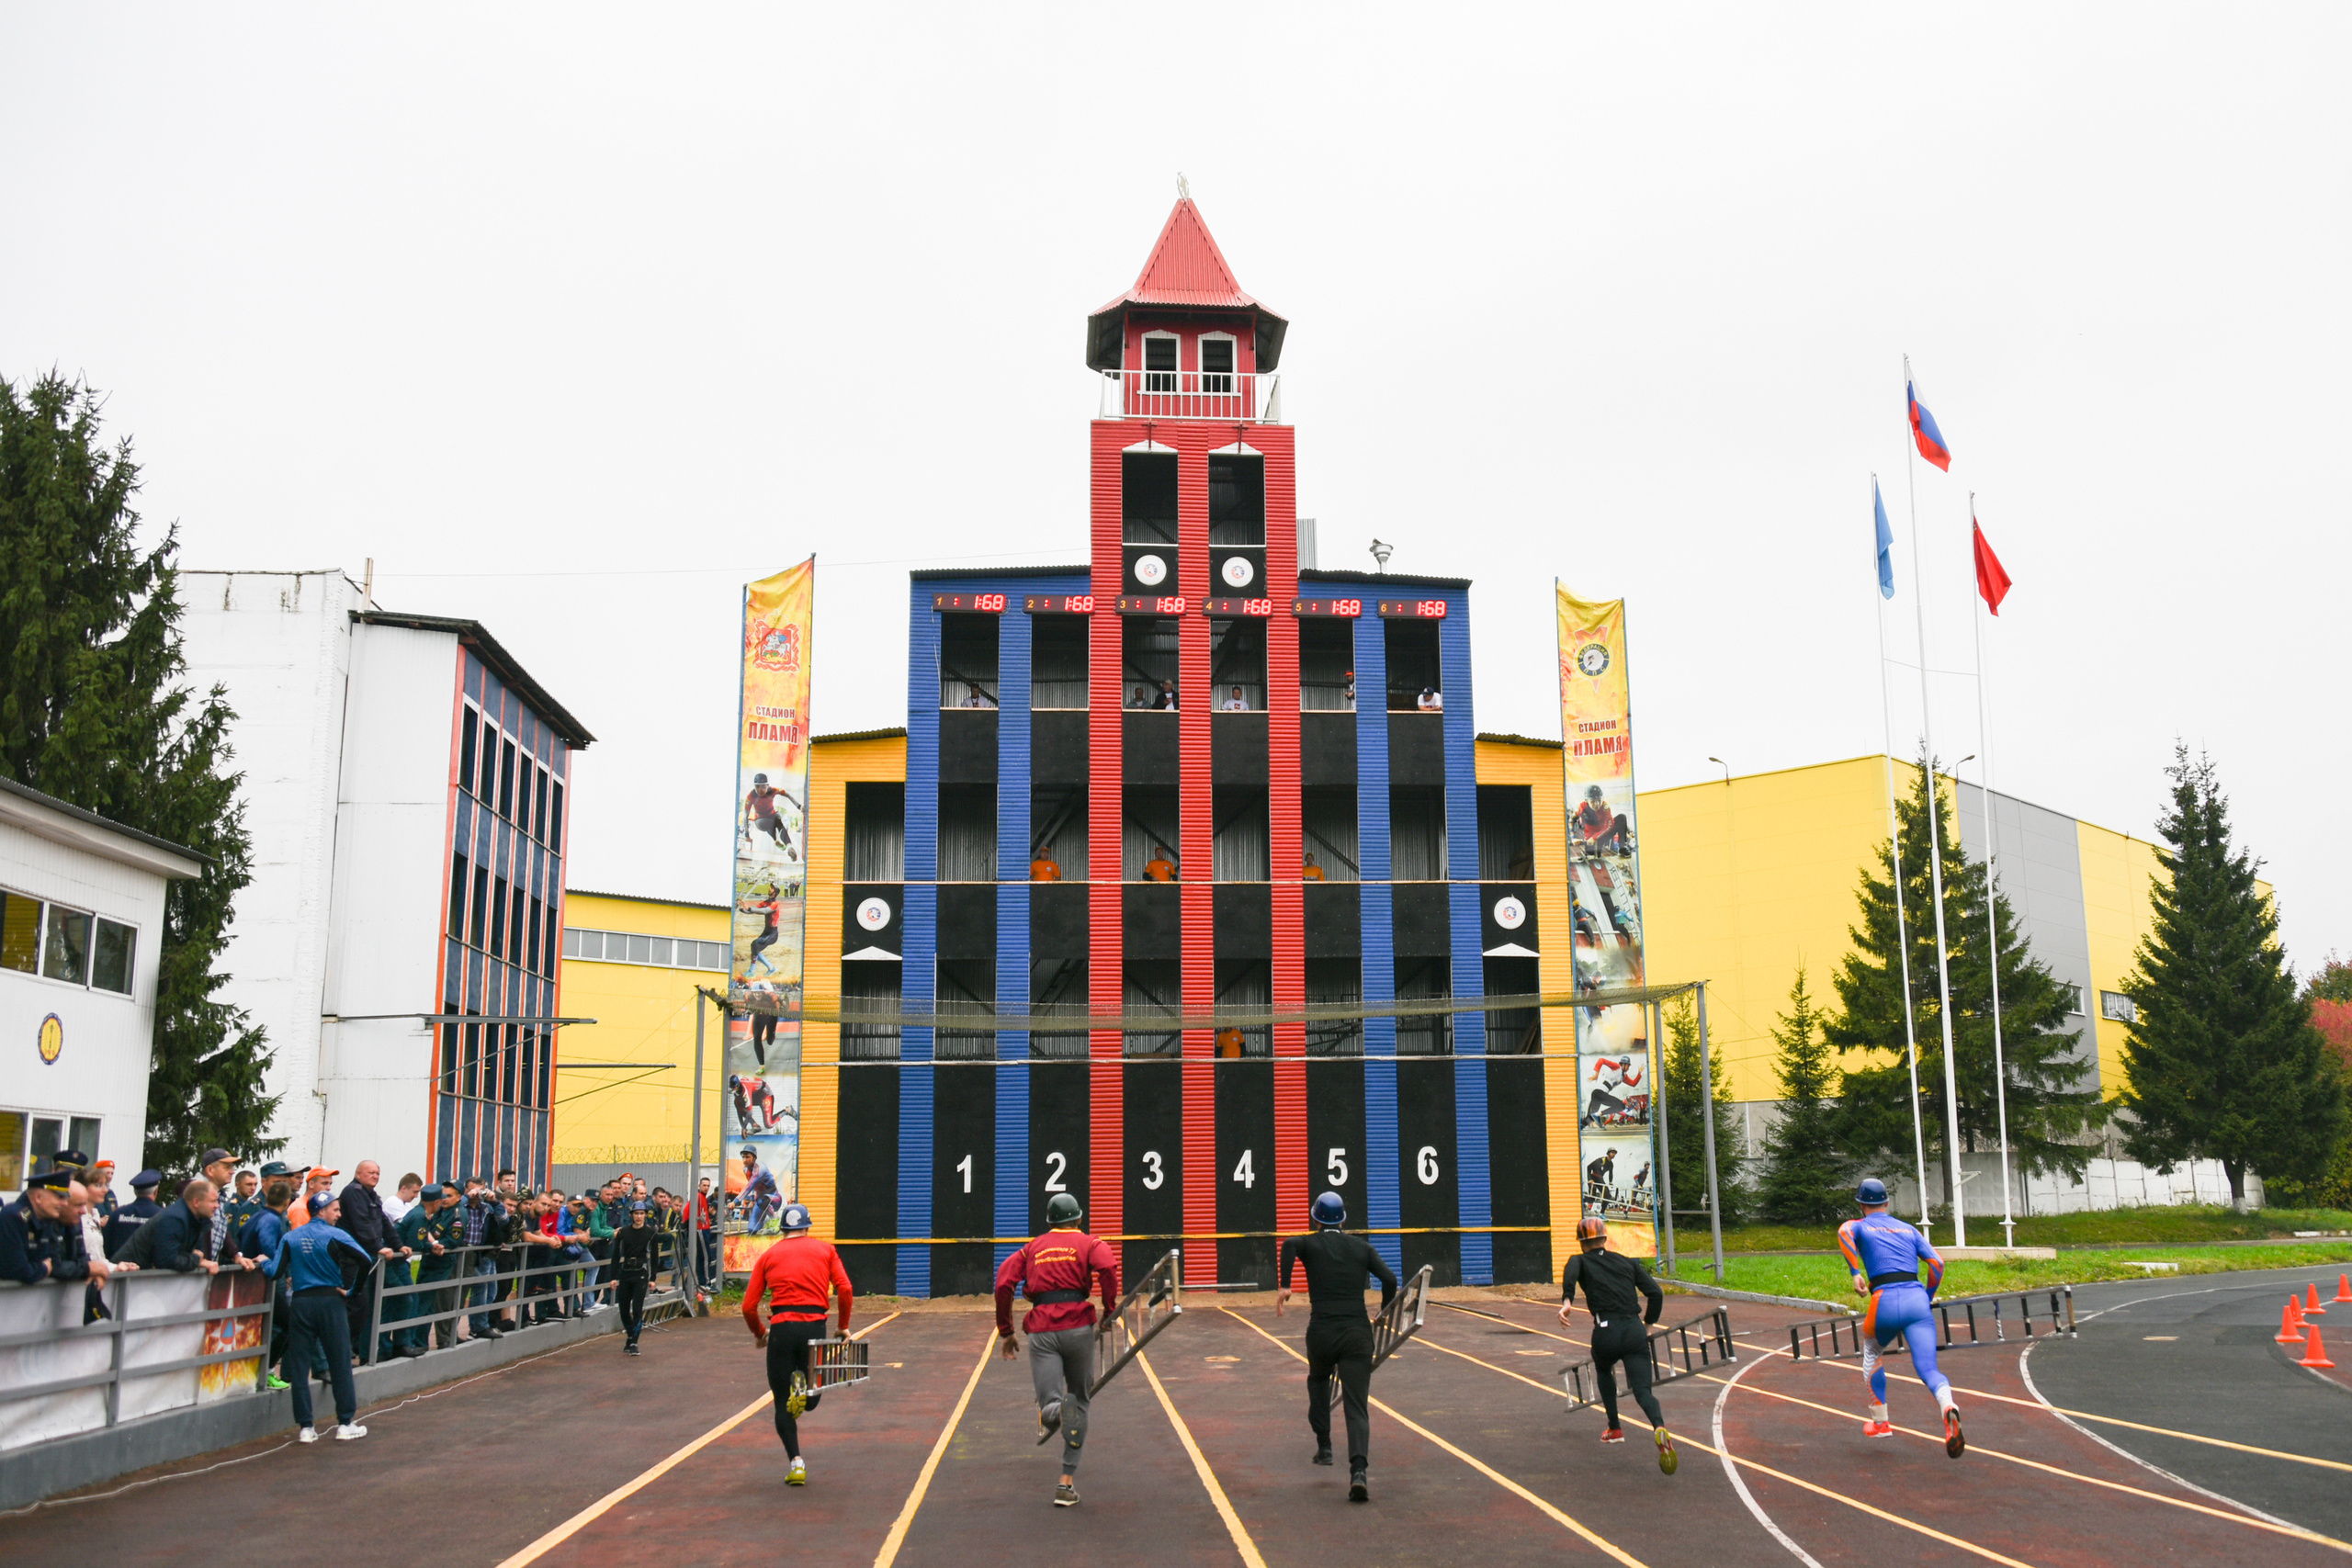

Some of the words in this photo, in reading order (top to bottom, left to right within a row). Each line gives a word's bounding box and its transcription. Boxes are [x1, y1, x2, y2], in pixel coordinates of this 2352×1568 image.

[936, 596, 943, 606] 1
[1027, 599, 1035, 608] 2
[1120, 599, 1126, 609] 3
[1205, 601, 1213, 610] 4
[1295, 603, 1302, 612] 5
[1381, 603, 1387, 613] 6
[755, 705, 796, 719] СТАДИОН
[748, 721, 798, 744] ПЛАМЯ
[1578, 719, 1617, 733] СТАДИОН
[1573, 735, 1623, 756] ПЛАМЯ
[956, 1154, 972, 1193] 1
[1045, 1152, 1067, 1191] 2
[1142, 1151, 1164, 1190] 3
[1233, 1149, 1255, 1189] 4
[1327, 1148, 1348, 1186] 5
[1417, 1146, 1439, 1185] 6
